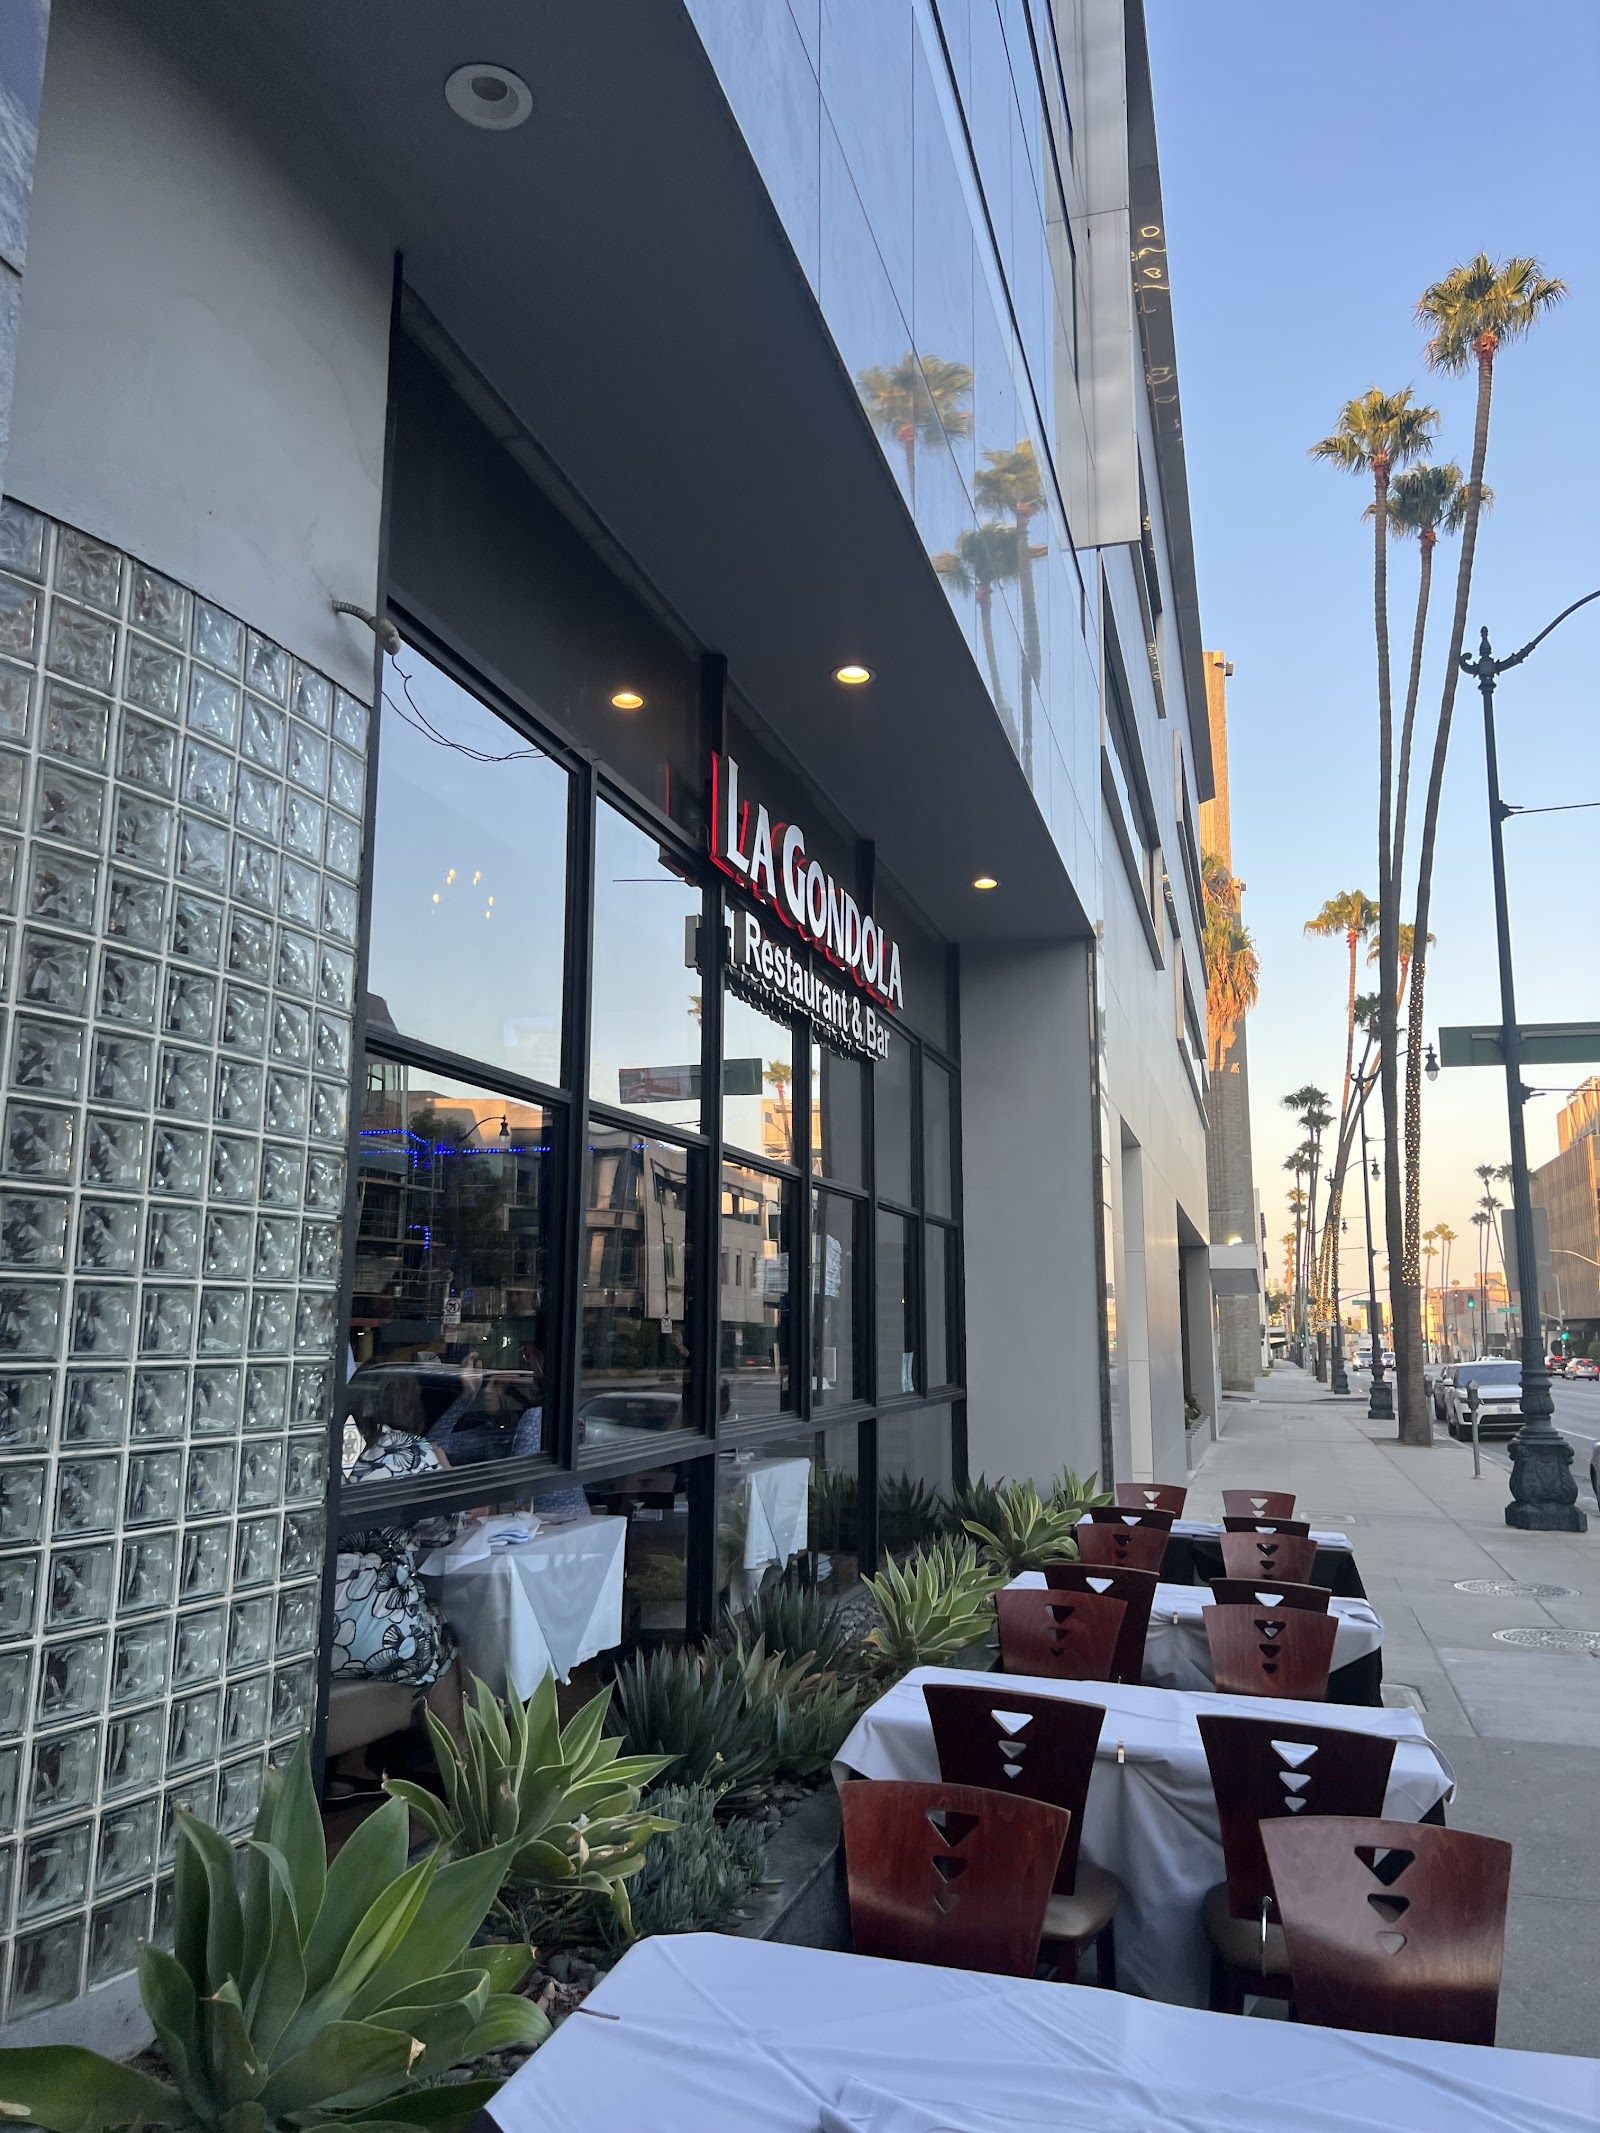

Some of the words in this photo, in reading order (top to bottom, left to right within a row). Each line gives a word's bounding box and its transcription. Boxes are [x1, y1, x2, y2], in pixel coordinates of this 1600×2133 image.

[726, 755, 777, 899] LA
[782, 824, 904, 1010] GONDOLA
[745, 910, 849, 1032] Restaurant
[851, 995, 864, 1043] &
[866, 1004, 891, 1059] Bar
